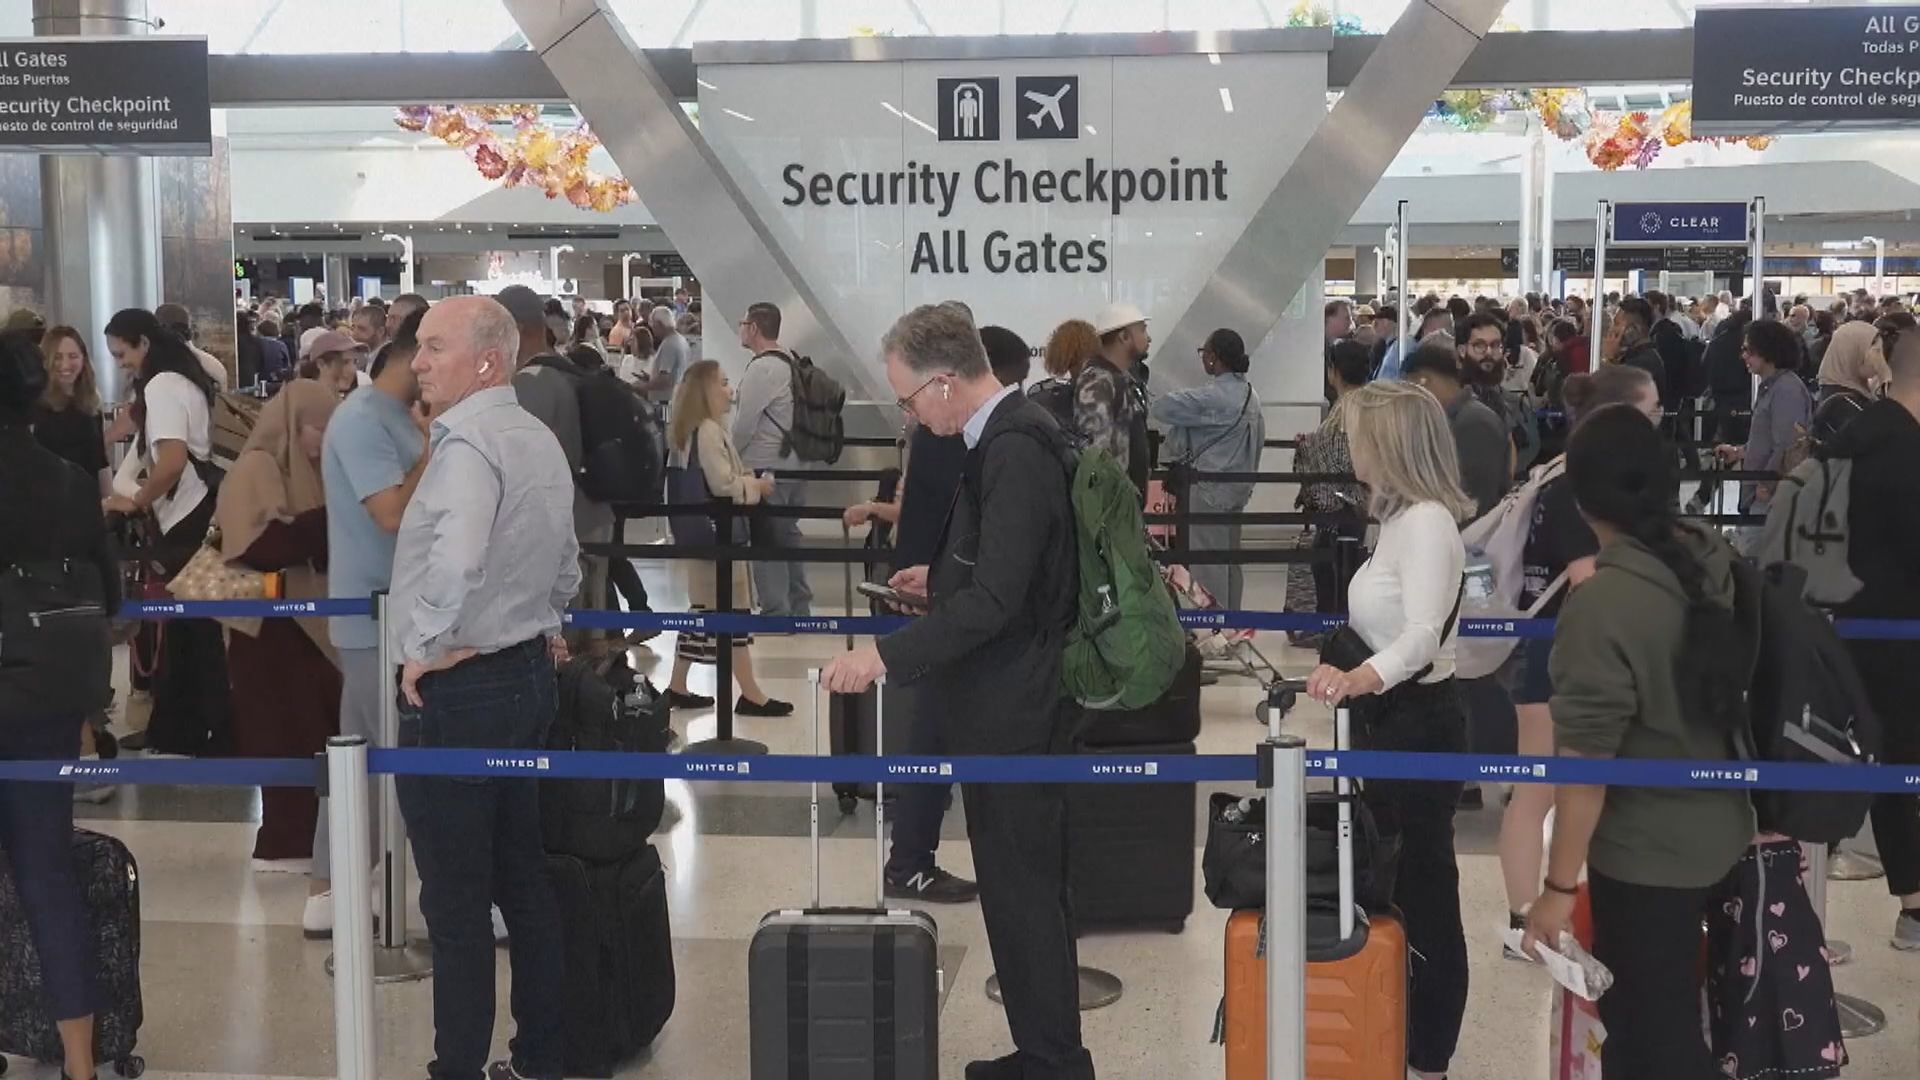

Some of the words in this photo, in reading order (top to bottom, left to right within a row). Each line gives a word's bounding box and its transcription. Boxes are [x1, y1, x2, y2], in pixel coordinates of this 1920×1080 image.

[1865, 16, 1896, 33] All
[1862, 41, 1904, 53] Todas
[15, 51, 68, 67] Gates
[23, 74, 70, 85] Puertas
[1742, 68, 1832, 90] Security
[1840, 66, 1920, 89] Checkp
[1734, 94, 1784, 105] Puesto
[1788, 94, 1806, 105] de
[1811, 93, 1863, 105] control
[1868, 93, 1886, 104] de
[66, 97, 171, 116] Checkpoint
[0, 121, 28, 131] esto
[32, 120, 47, 131] de
[51, 120, 94, 131] control
[98, 120, 113, 131] de
[117, 118, 178, 133] seguridad
[782, 161, 960, 217] Security
[974, 158, 1228, 215] Checkpoint
[1670, 217, 1719, 227] CLEAR
[910, 230, 969, 274] All
[983, 231, 1108, 274] Gates
[142, 605, 174, 613] UNITED
[272, 603, 305, 611] UNITED
[1179, 615, 1214, 623] UNITED
[795, 621, 827, 629] UNITED
[1468, 622, 1503, 630] UNITED
[486, 759, 535, 768] UNITED
[687, 764, 735, 772] UNITED
[889, 765, 938, 774] UNITED
[1092, 765, 1142, 773] UNITED
[1480, 765, 1530, 775] UNITED
[1691, 770, 1742, 779] UNITED
